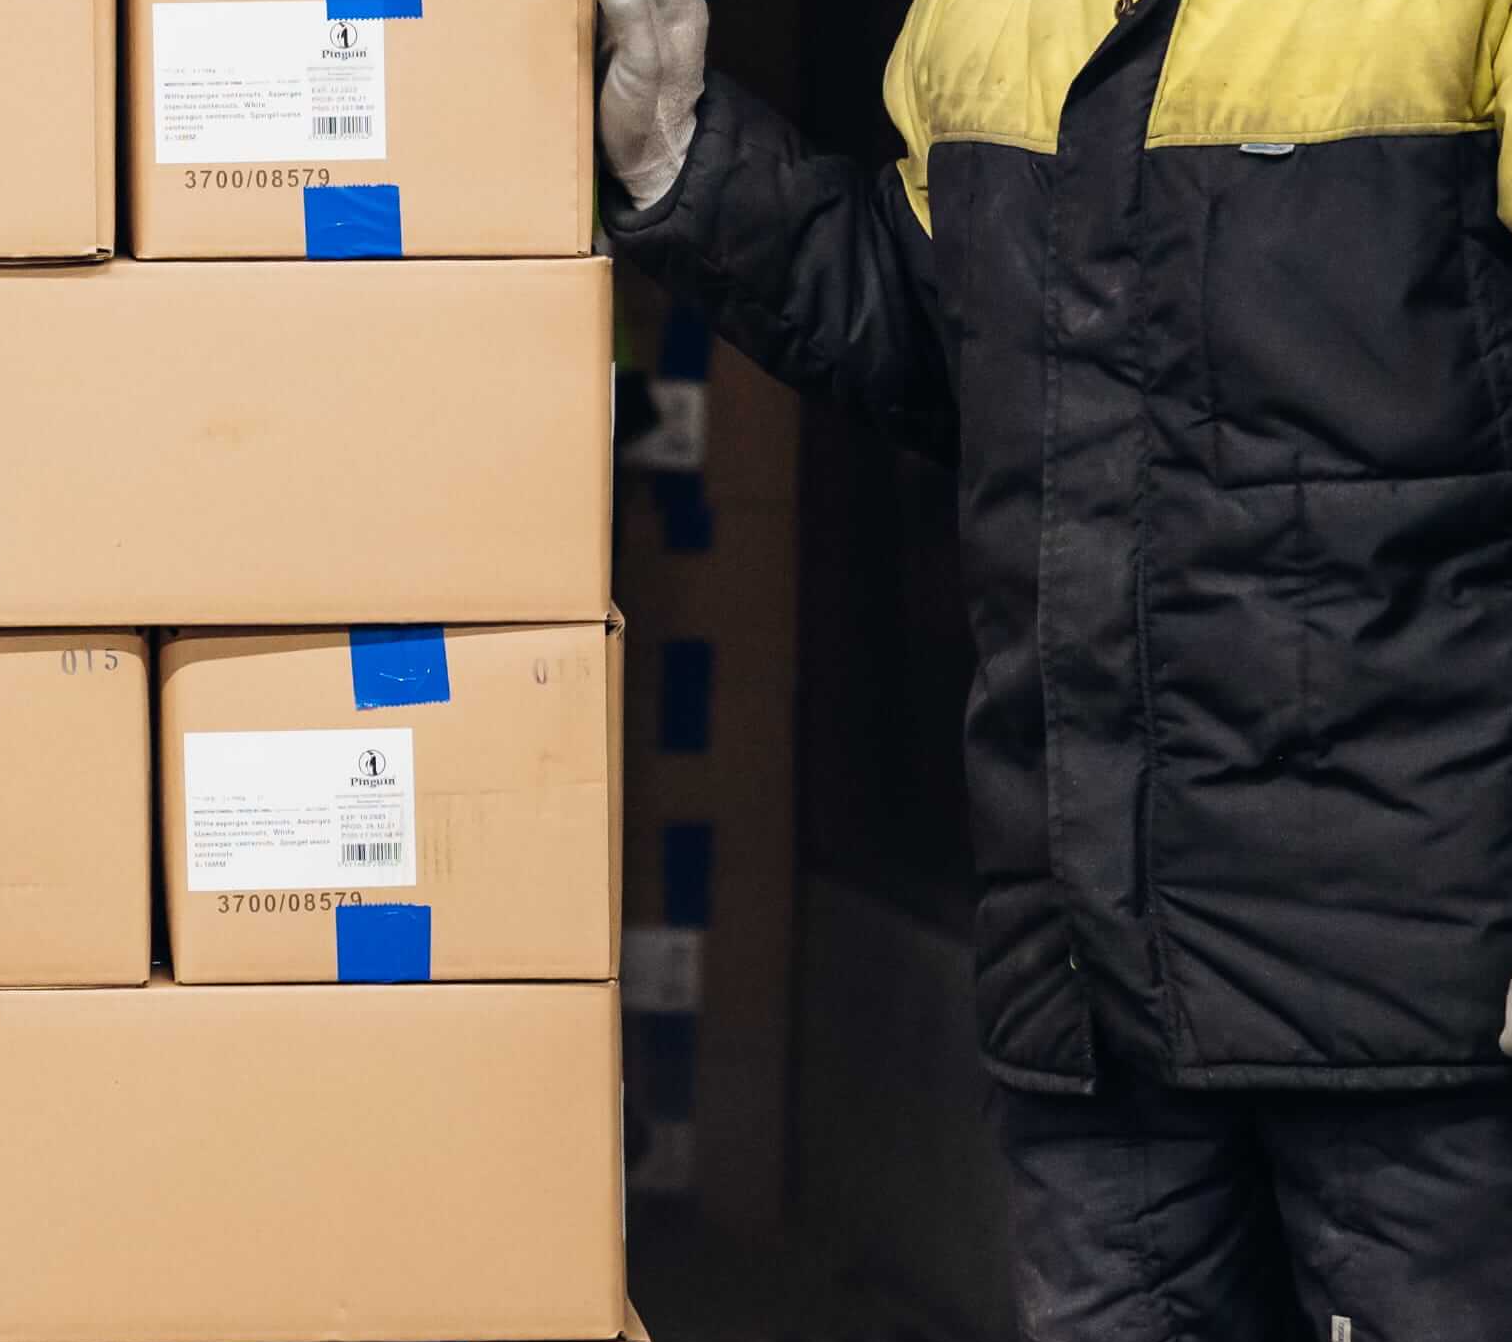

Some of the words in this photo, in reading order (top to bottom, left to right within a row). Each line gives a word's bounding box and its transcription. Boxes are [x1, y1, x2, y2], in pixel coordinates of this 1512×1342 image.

[321, 48, 367, 61] Pinguin
[184, 167, 330, 190] 3700/08579
[61, 647, 119, 676] 015
[350, 776, 395, 788] Pinguin
